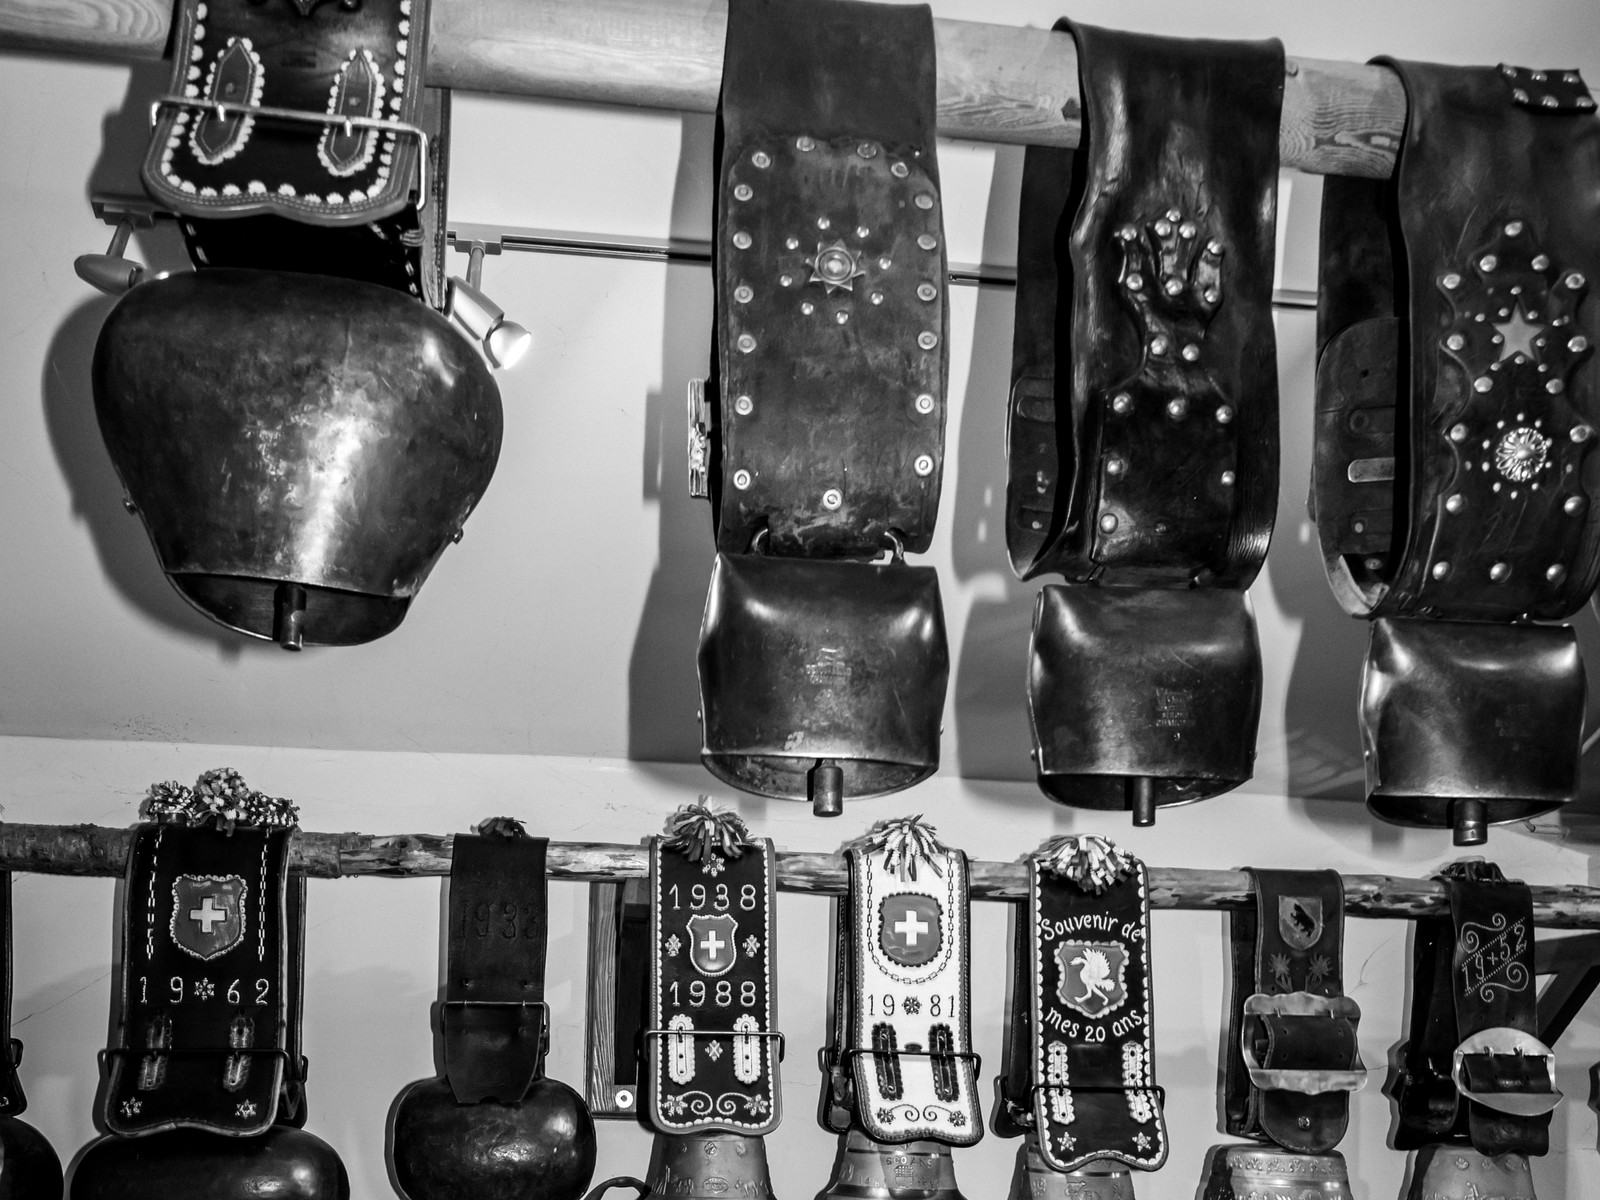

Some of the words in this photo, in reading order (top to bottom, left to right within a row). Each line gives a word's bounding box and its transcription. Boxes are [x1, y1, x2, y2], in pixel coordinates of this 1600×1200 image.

[668, 883, 757, 912] 1938
[1040, 912, 1119, 942] Souvenir
[1120, 914, 1142, 943] de
[666, 980, 757, 1008] 1988
[1045, 1005, 1081, 1038] mes
[1084, 1023, 1107, 1042] 20
[1110, 1010, 1144, 1037] ans
